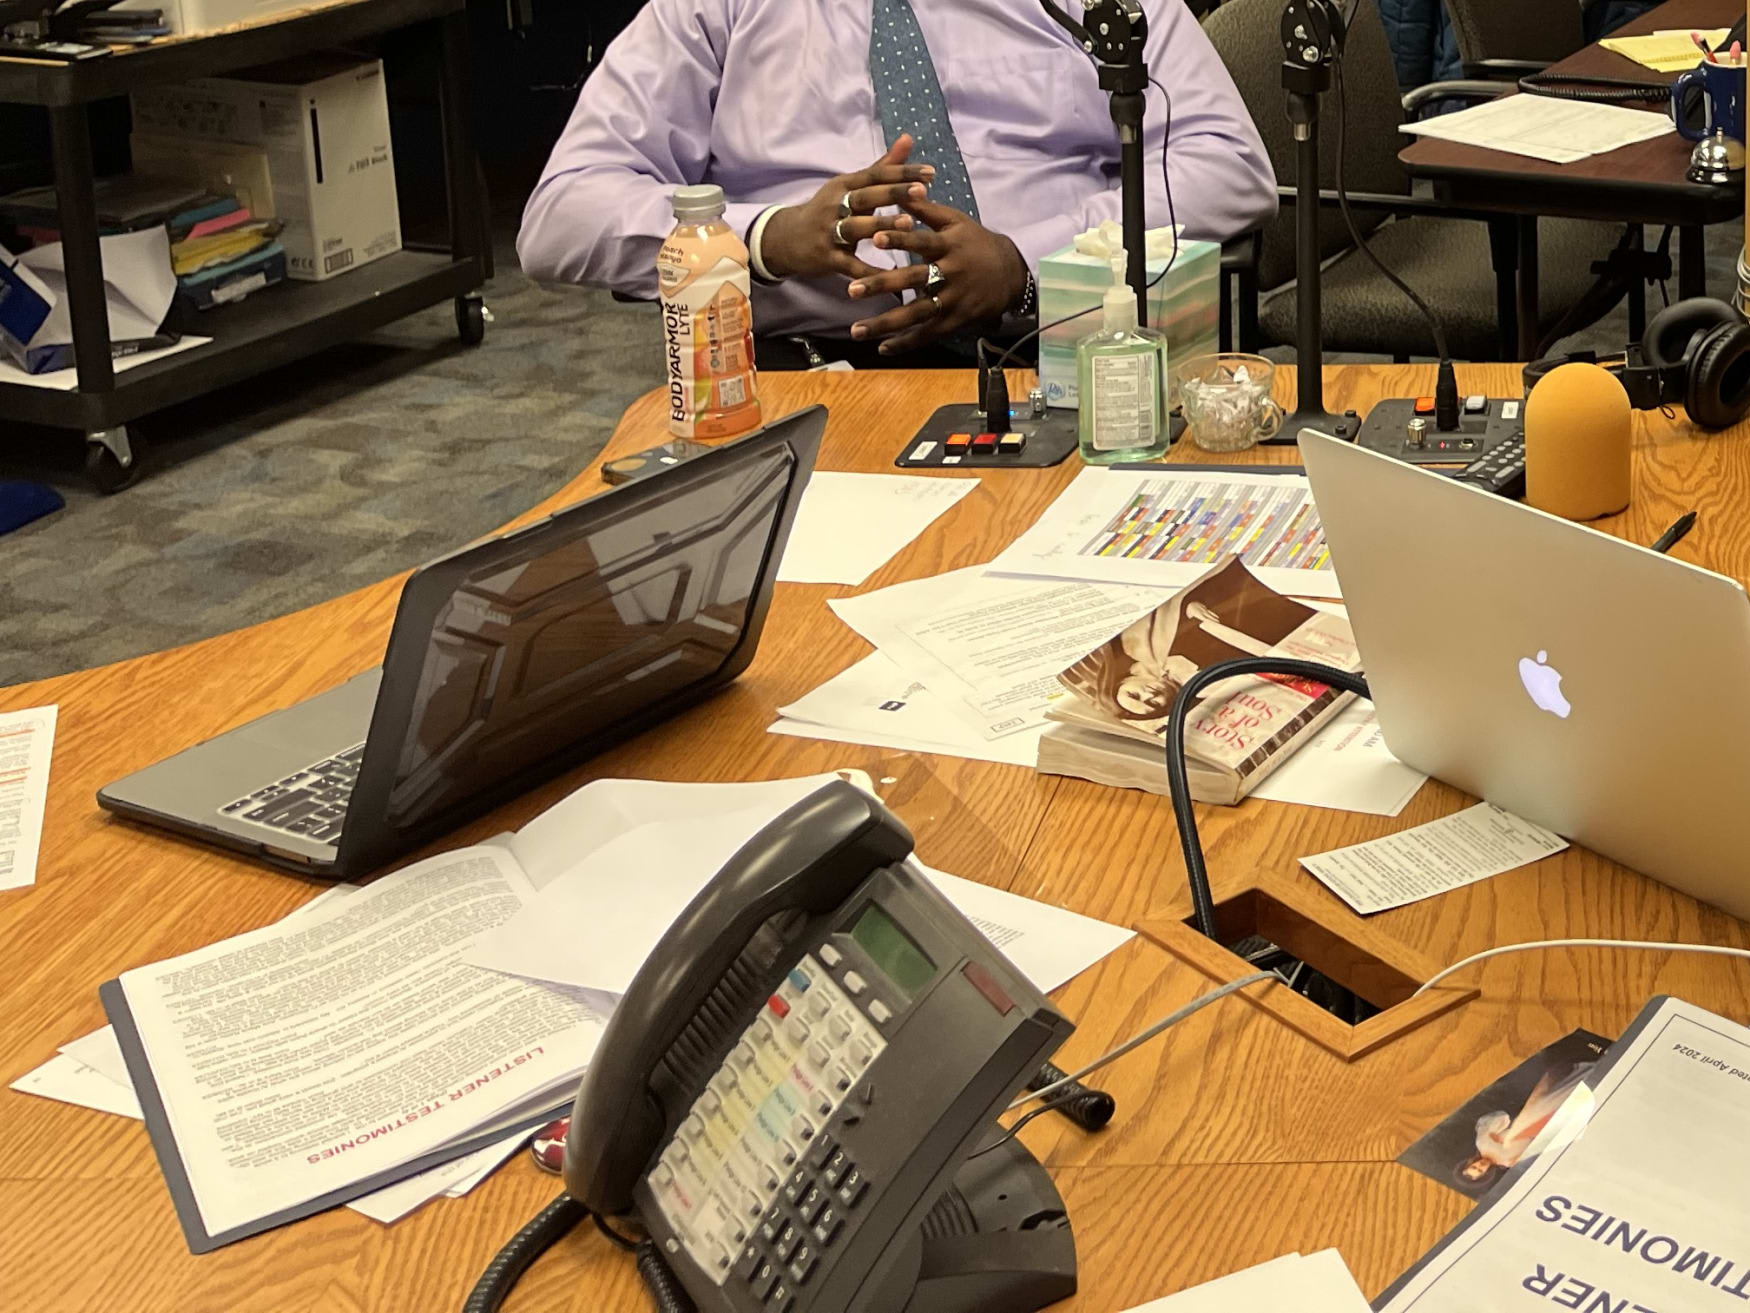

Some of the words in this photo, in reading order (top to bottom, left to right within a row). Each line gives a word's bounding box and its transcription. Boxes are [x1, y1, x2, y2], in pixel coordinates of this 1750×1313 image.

[678, 304, 691, 336] LYTE
[665, 302, 685, 422] BODYARMOR
[1672, 1043, 1699, 1060] 2024
[1700, 1055, 1728, 1073] April
[449, 1046, 545, 1102] LISTENER
[307, 1101, 445, 1165] TESTIMONIES
